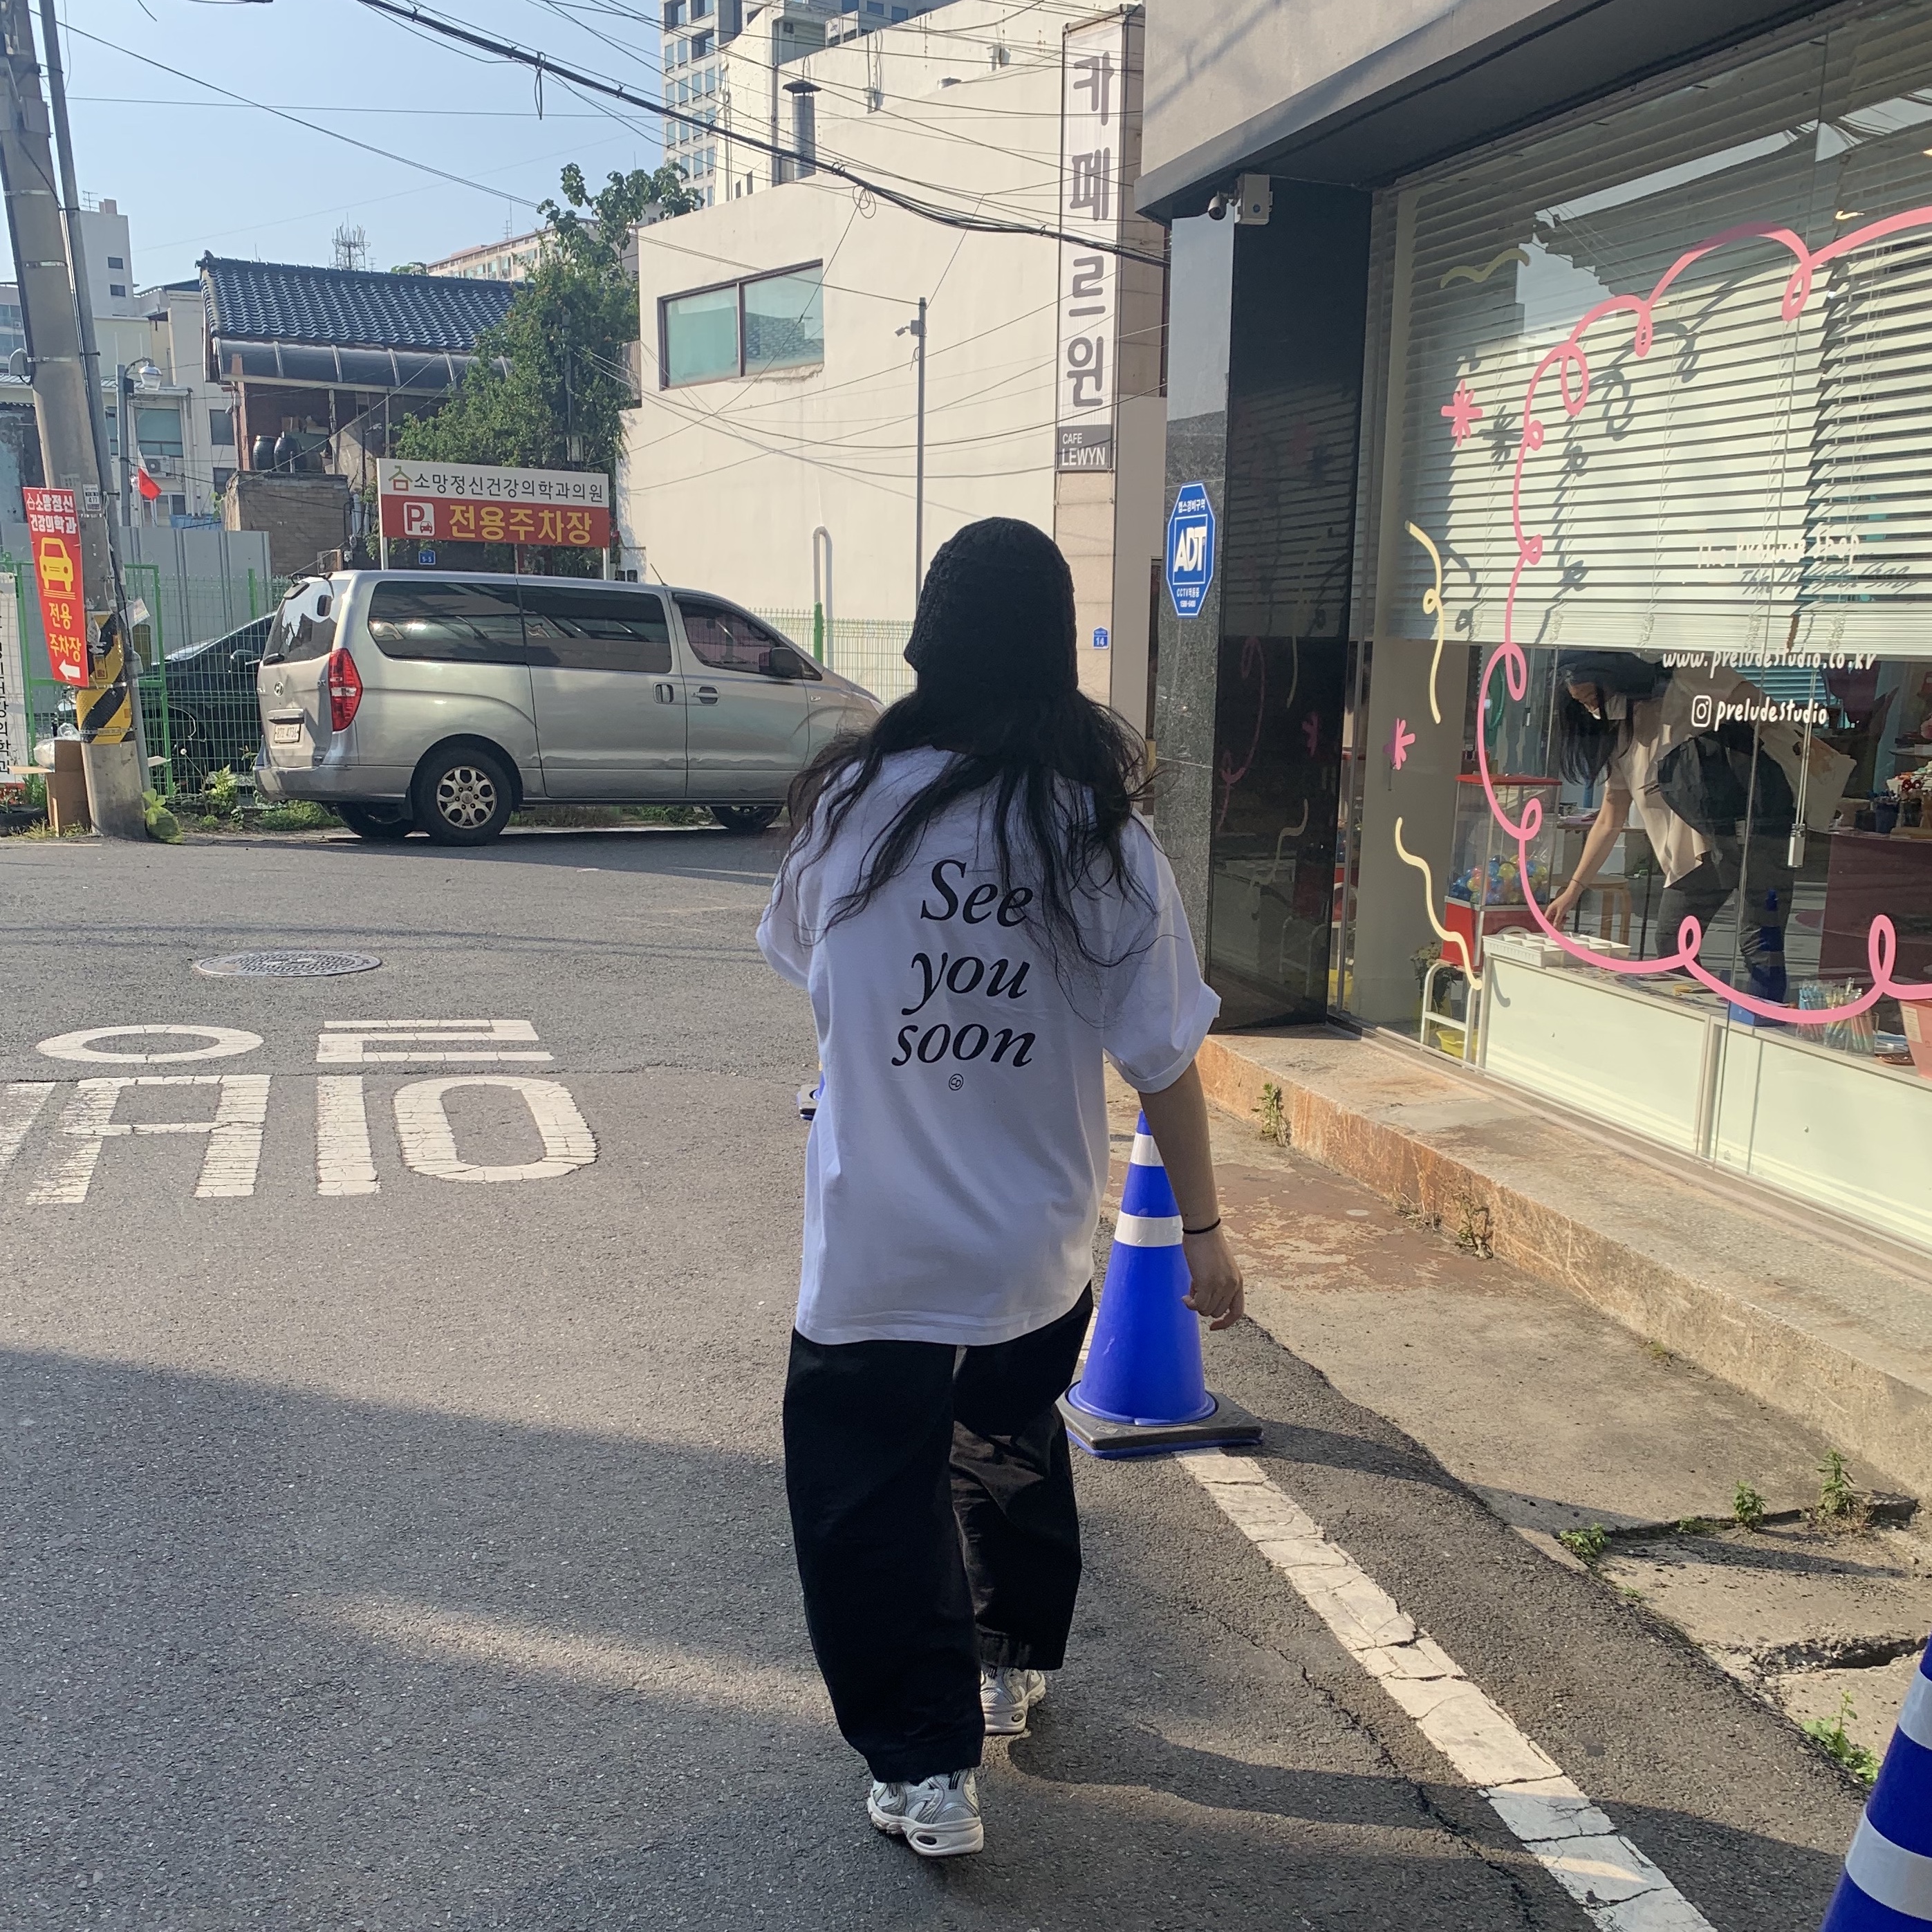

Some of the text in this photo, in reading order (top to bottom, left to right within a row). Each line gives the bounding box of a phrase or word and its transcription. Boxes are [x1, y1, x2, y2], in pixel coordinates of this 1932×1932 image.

[1062, 432, 1083, 445] CAFE
[1061, 447, 1106, 466] LEWYN
[414, 472, 604, 503] 소망정신건강의학과의원
[29, 514, 77, 535] 건강의학과
[406, 504, 425, 532] P
[449, 504, 593, 545] 전용주차장
[1173, 526, 1207, 573] ADT
[48, 602, 73, 631] 전용
[49, 633, 82, 663] 주차장
[1095, 636, 1105, 646] 14
[1714, 696, 1828, 732] preludestudio
[920, 859, 1034, 927] See
[900, 951, 1030, 1016] you
[891, 1022, 1037, 1068] soon
